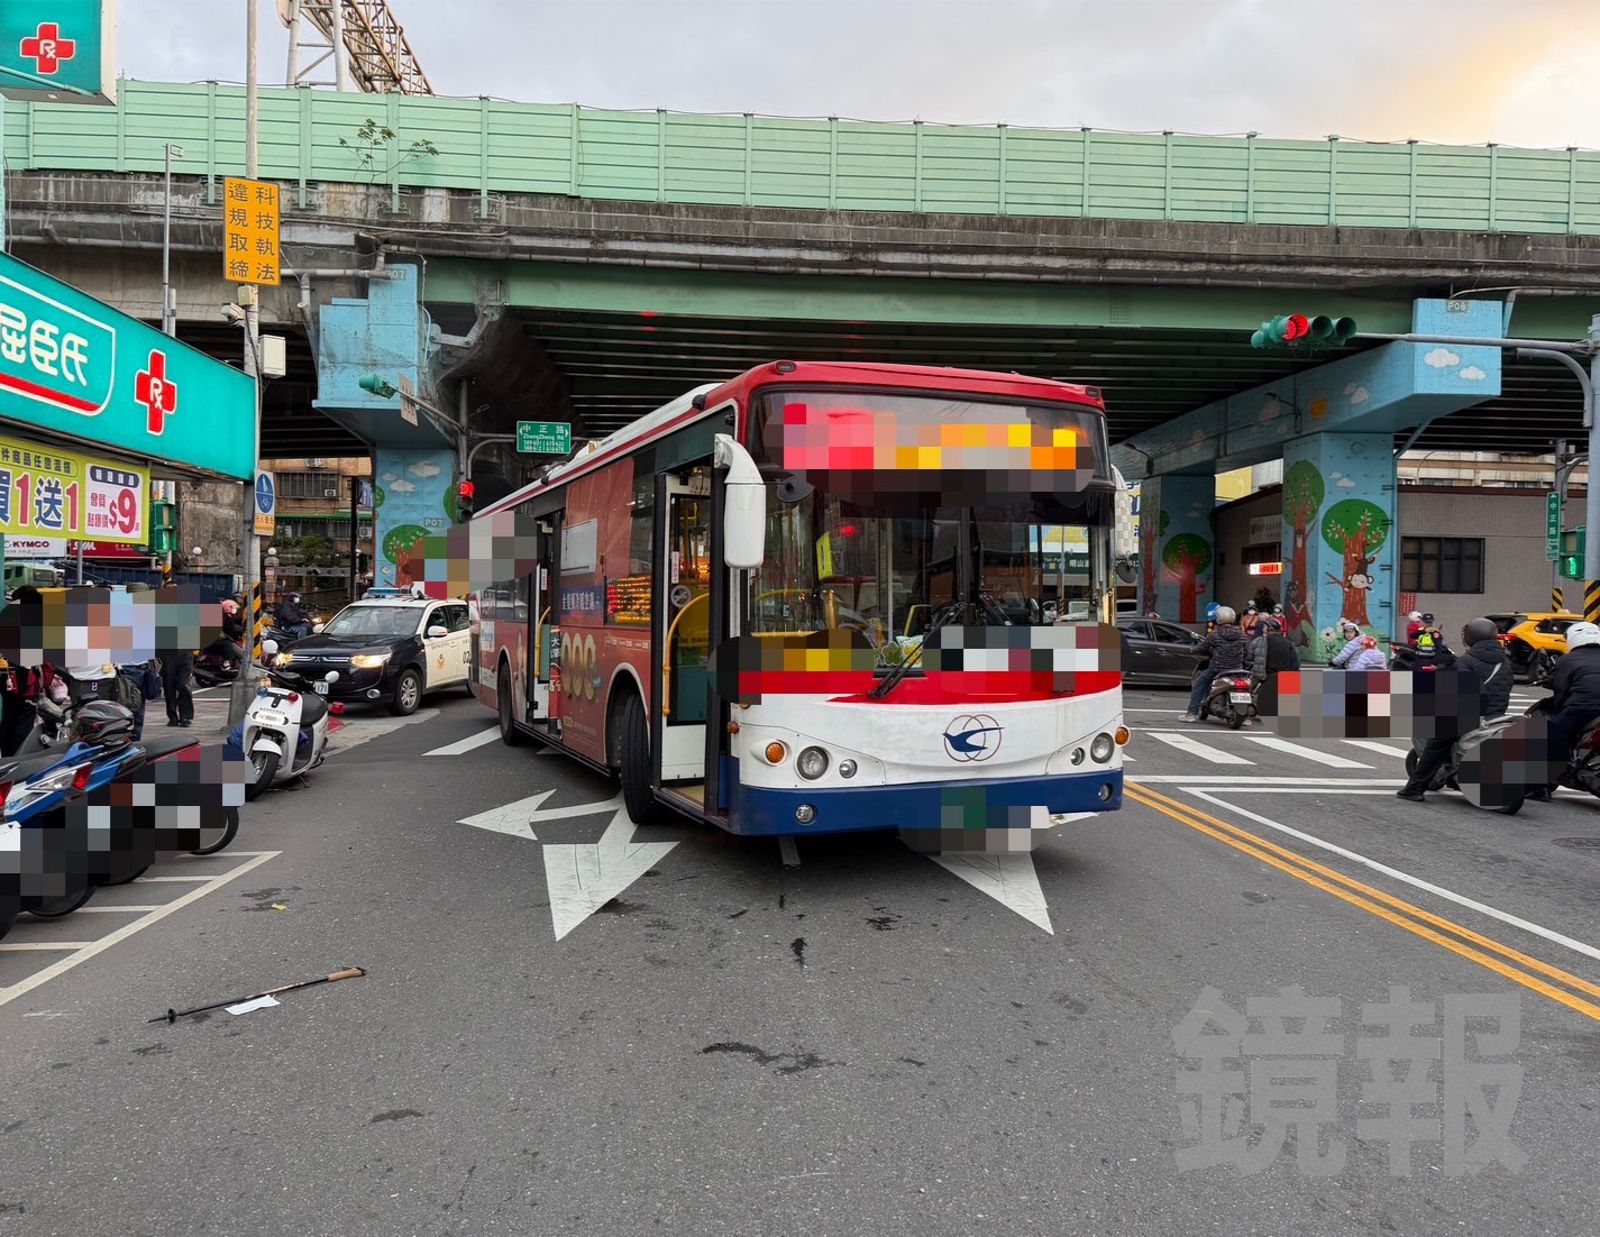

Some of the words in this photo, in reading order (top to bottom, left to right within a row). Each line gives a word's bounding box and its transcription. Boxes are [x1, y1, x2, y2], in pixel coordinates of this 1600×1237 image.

[228, 182, 249, 278] 違規取締
[255, 186, 275, 281] 科技執法
[12, 540, 50, 548] KYMCO
